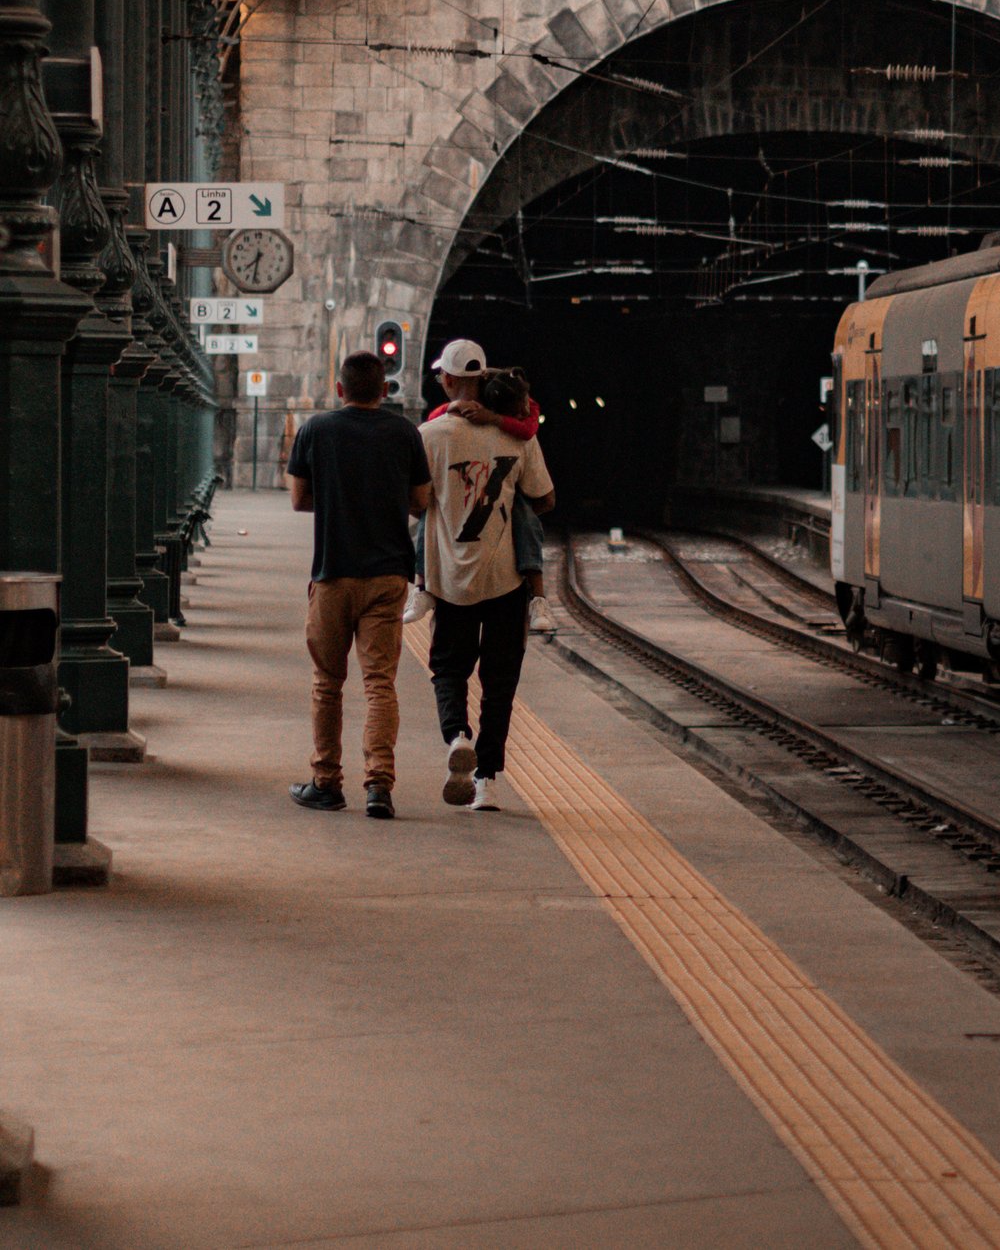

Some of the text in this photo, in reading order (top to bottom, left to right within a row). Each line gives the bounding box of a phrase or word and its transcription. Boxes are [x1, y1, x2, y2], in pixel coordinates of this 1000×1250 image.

[201, 190, 226, 198] Linha
[157, 197, 177, 217] A
[207, 200, 222, 221] 2
[197, 305, 231, 319] B 2
